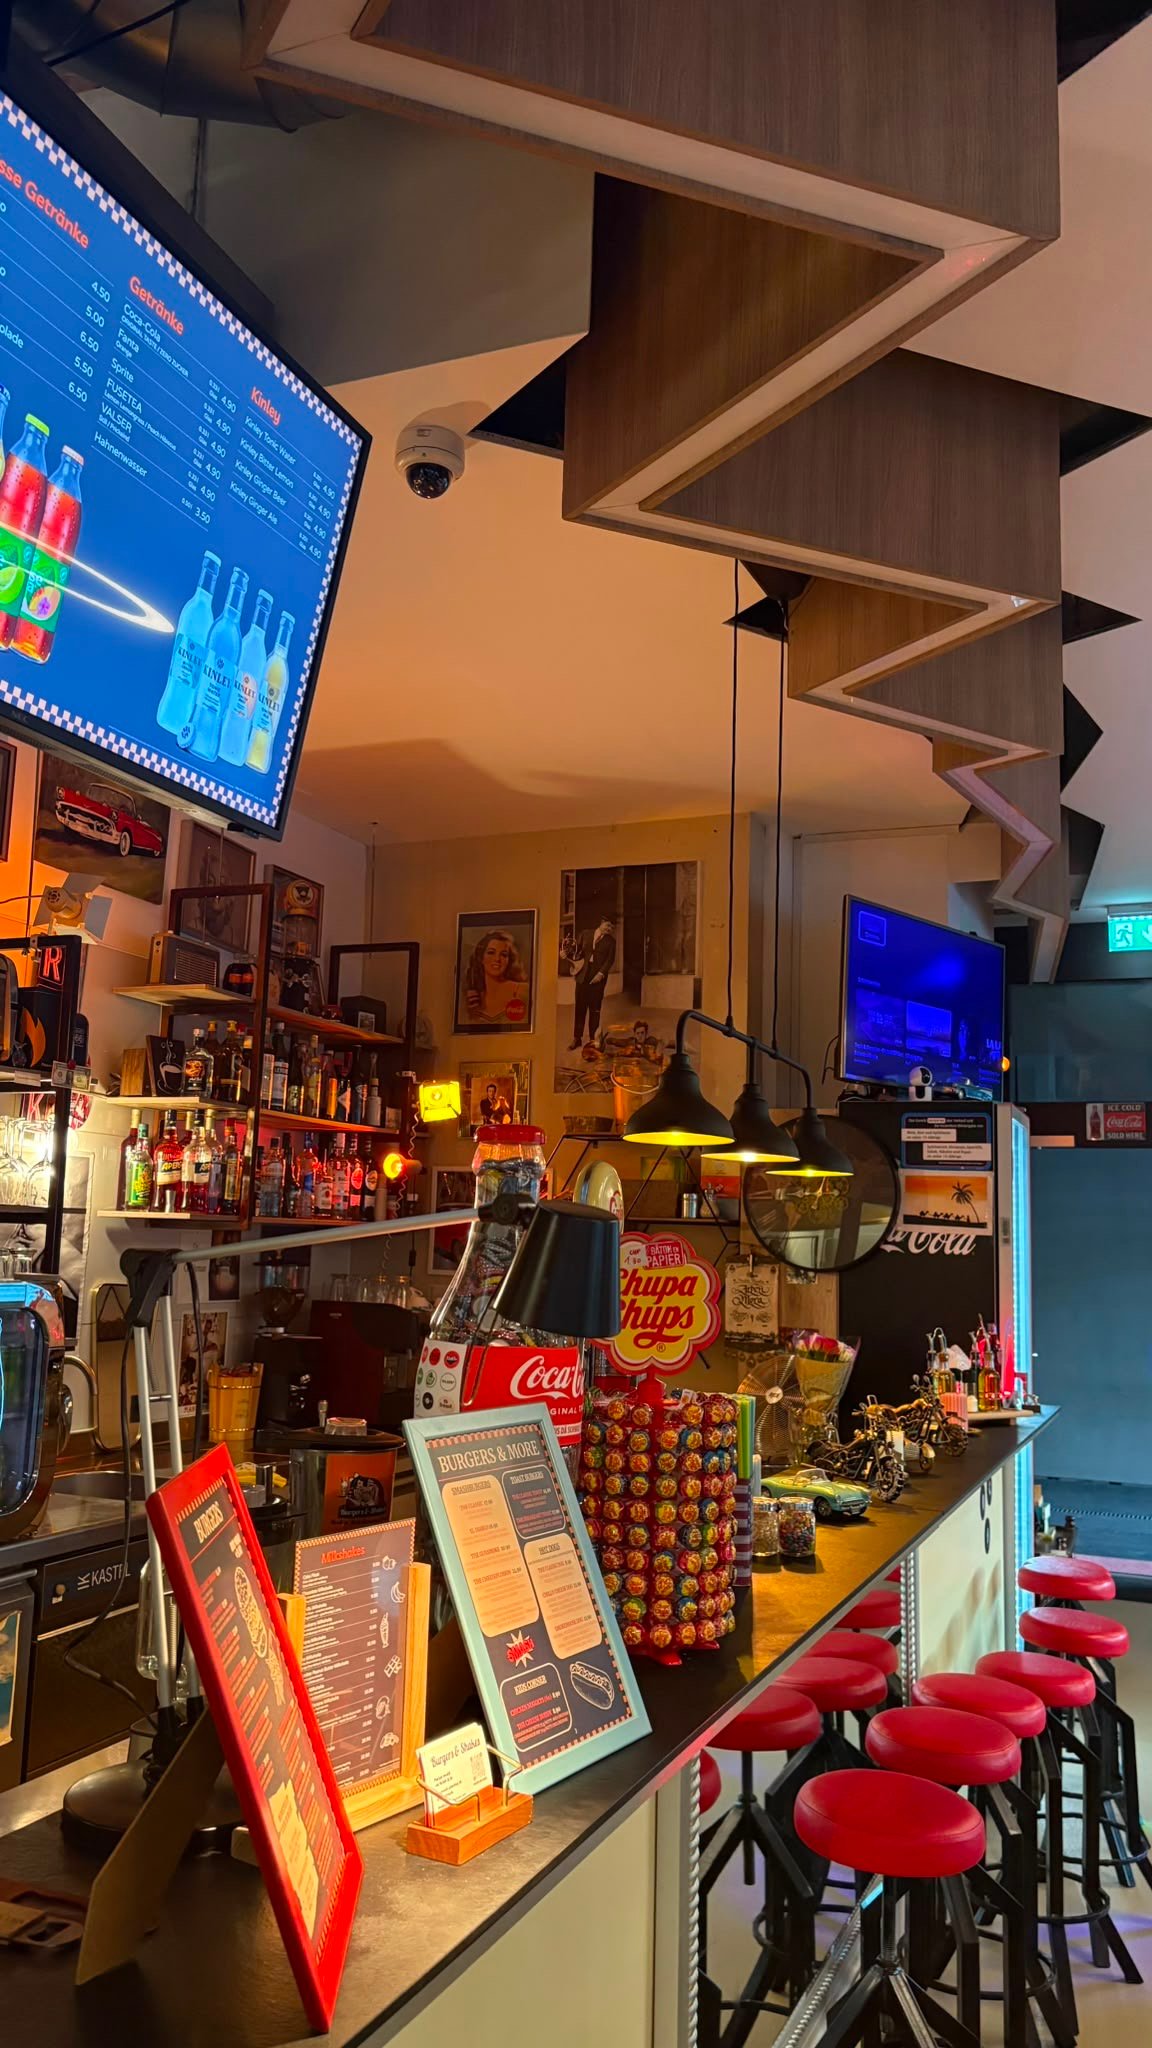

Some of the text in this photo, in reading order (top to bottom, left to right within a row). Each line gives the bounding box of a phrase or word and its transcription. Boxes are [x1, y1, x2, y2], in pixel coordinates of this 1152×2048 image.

[25, 180, 89, 249] Getränke
[91, 281, 111, 303] 4.50
[85, 305, 105, 327] 5.00
[129, 276, 184, 336] Getränke
[123, 303, 161, 342] Coca-Cola
[79, 331, 99, 352] 6.50
[117, 327, 140, 353] Fanta
[73, 355, 94, 377] 5.50
[111, 357, 134, 383] Sprite
[68, 381, 88, 402] 6.50
[106, 378, 142, 414] FUSETEA
[221, 396, 236, 413] 4.90
[250, 386, 281, 426] Kinley
[101, 402, 132, 433] VALSER
[216, 418, 231, 435] 4.90
[210, 441, 226, 458] 4.90
[244, 415, 297, 466] Kinley Tonic Water
[94, 431, 148, 477] Hahnenwasser
[239, 437, 258, 460] Kinley
[275, 466, 294, 489] Lemon
[205, 463, 221, 480] 4.90
[200, 485, 216, 502] 4.90
[234, 459, 288, 507] Kinley Ginger Beer
[322, 484, 336, 500] 4.90
[229, 481, 248, 503] Kinley
[248, 494, 268, 519] Ginger
[195, 507, 211, 524] 3.50
[317, 504, 331, 520] 4.90
[313, 524, 327, 540] 4.90
[308, 544, 322, 559] 4.90
[647, 1253, 681, 1267] PAPIER
[550, 1407, 577, 1416] GINAL
[437, 1440, 540, 1473] BURGERS & MORE
[193, 1501, 224, 1544] BURGERS
[321, 1545, 366, 1564] Milkshakes
